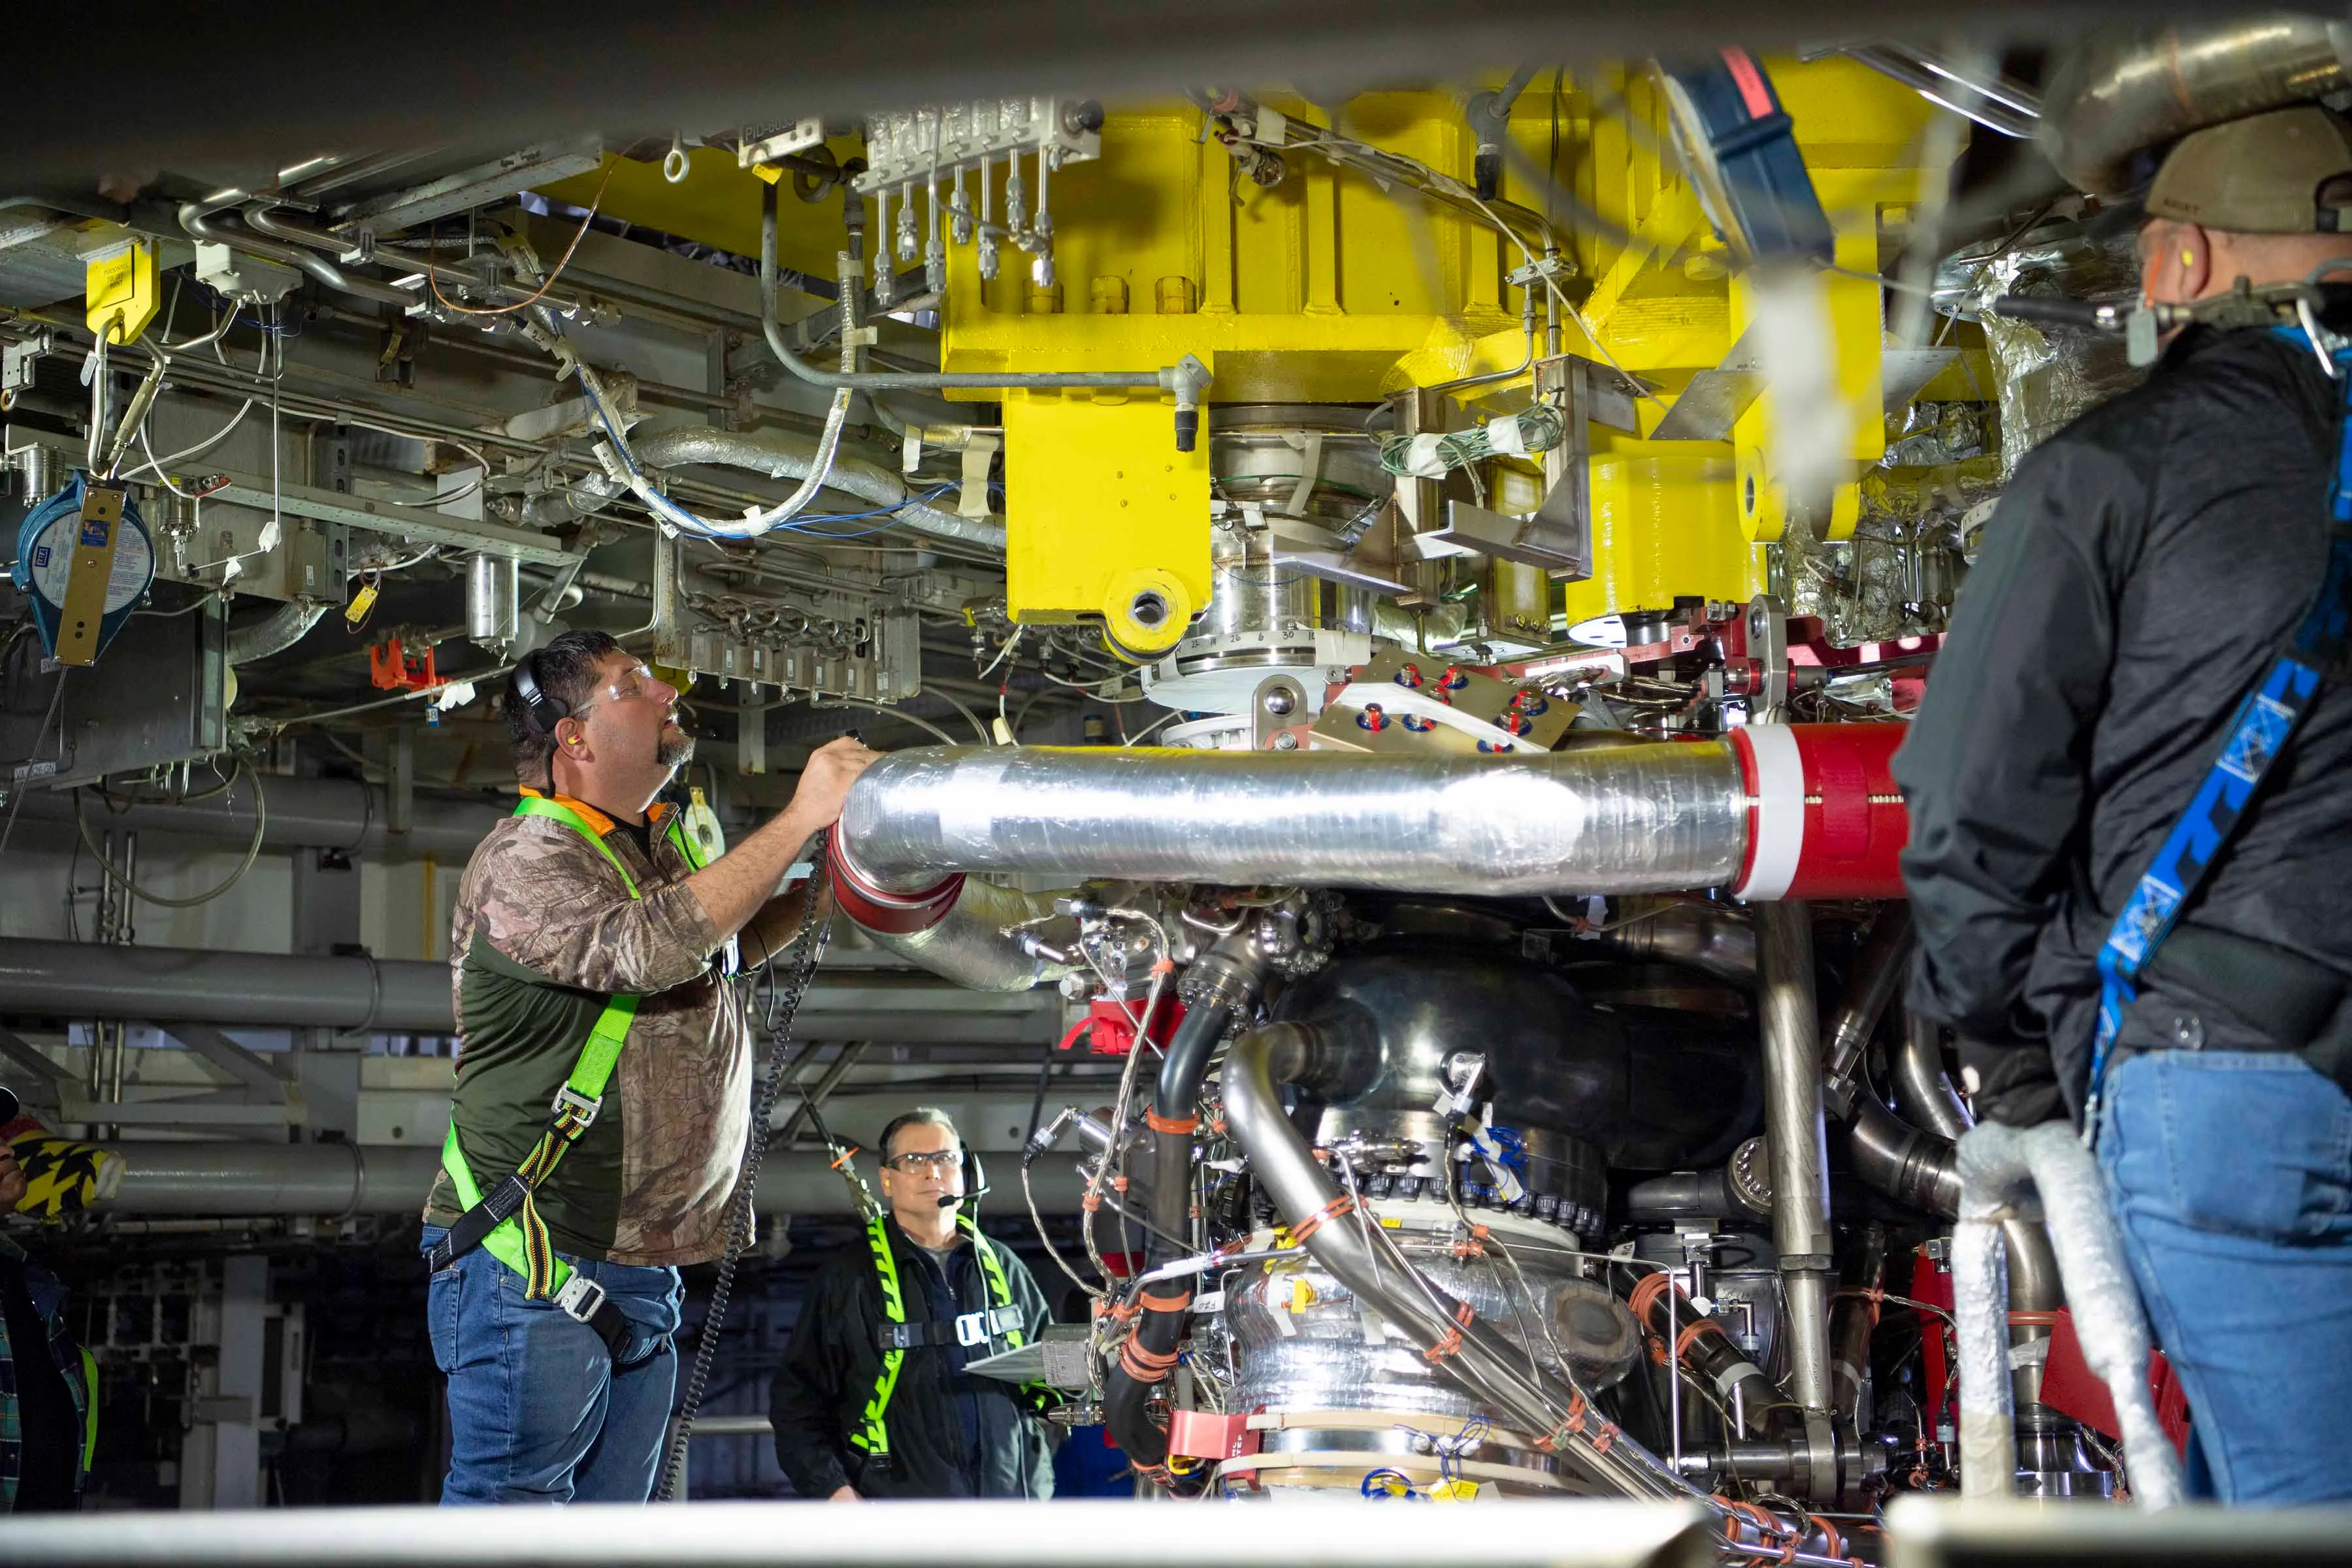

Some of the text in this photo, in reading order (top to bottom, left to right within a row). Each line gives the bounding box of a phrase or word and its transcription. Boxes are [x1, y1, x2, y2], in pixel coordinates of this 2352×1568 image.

[110, 280, 123, 289] POINT
[1230, 634, 1241, 643] 26
[1258, 632, 1264, 641] 6
[1282, 631, 1294, 640] 30
